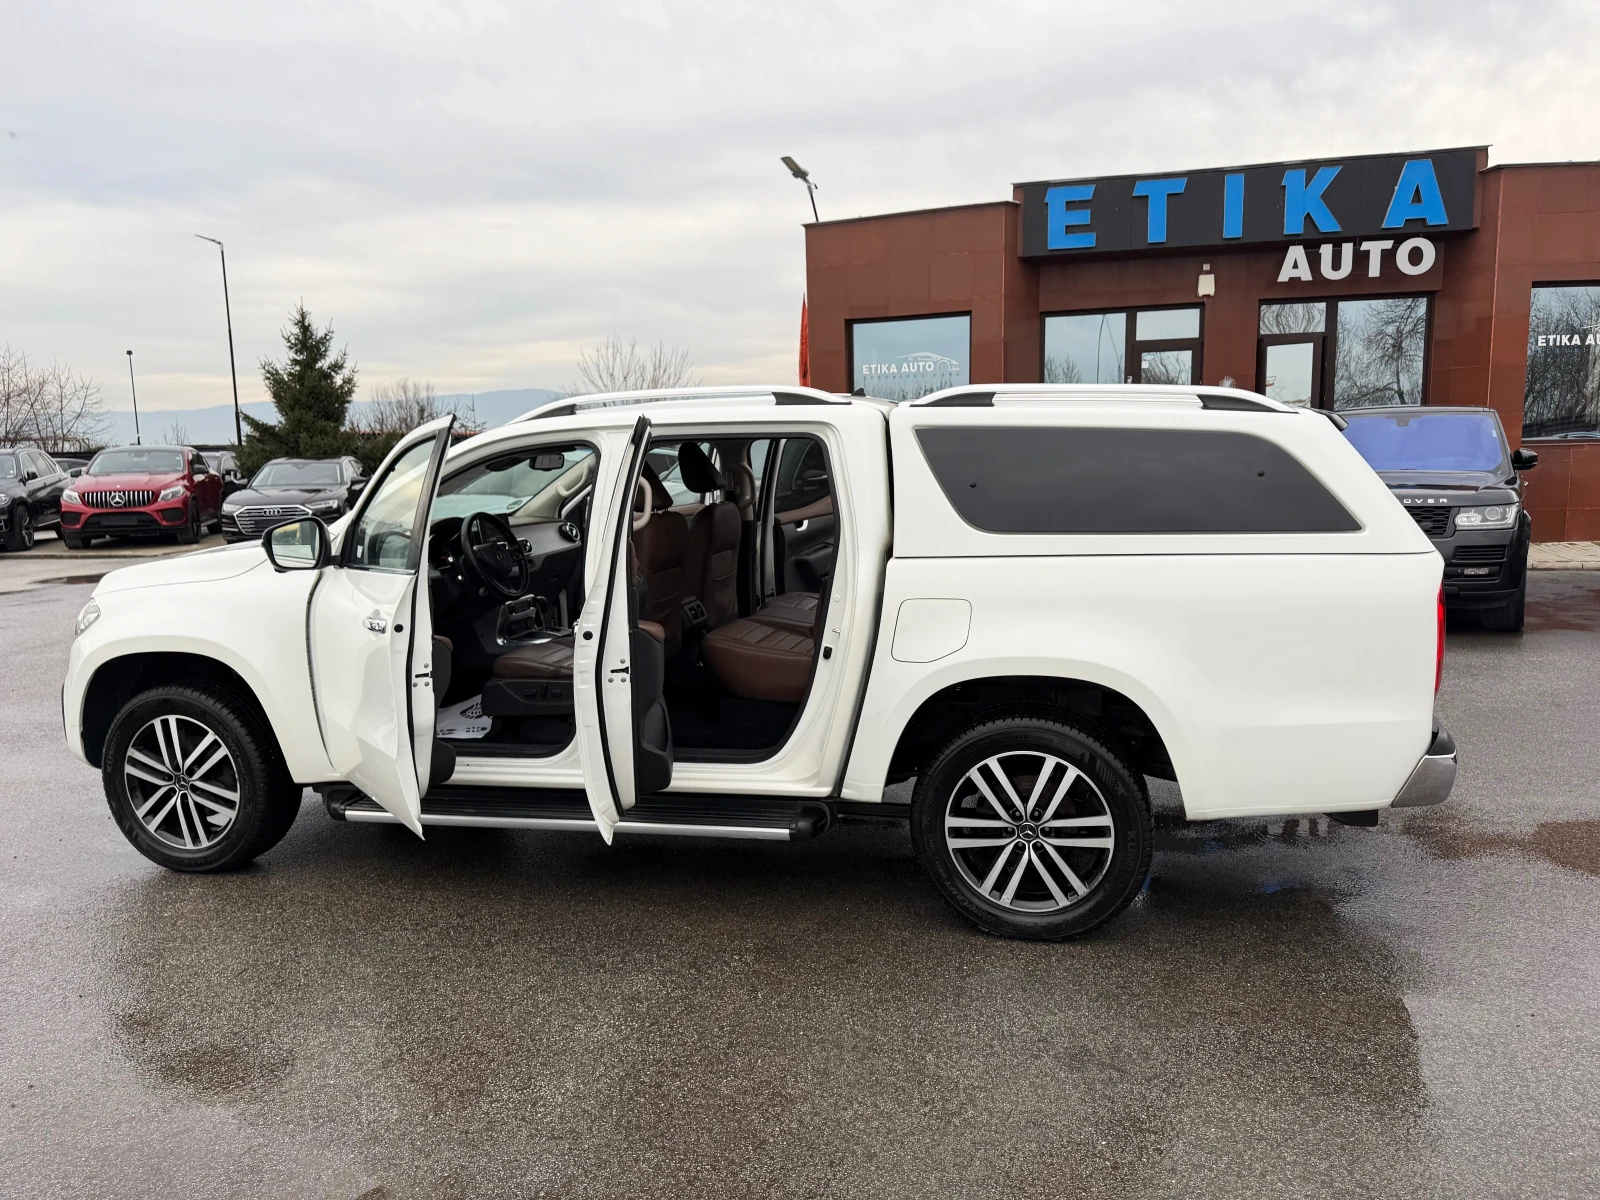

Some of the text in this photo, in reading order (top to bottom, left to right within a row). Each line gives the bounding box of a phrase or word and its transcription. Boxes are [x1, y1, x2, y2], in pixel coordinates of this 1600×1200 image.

[1044, 158, 1449, 250] ETIKA
[1276, 237, 1436, 283] AUTO
[1537, 334, 1581, 346] ETIKA
[862, 361, 935, 374] ETIKA AUTO
